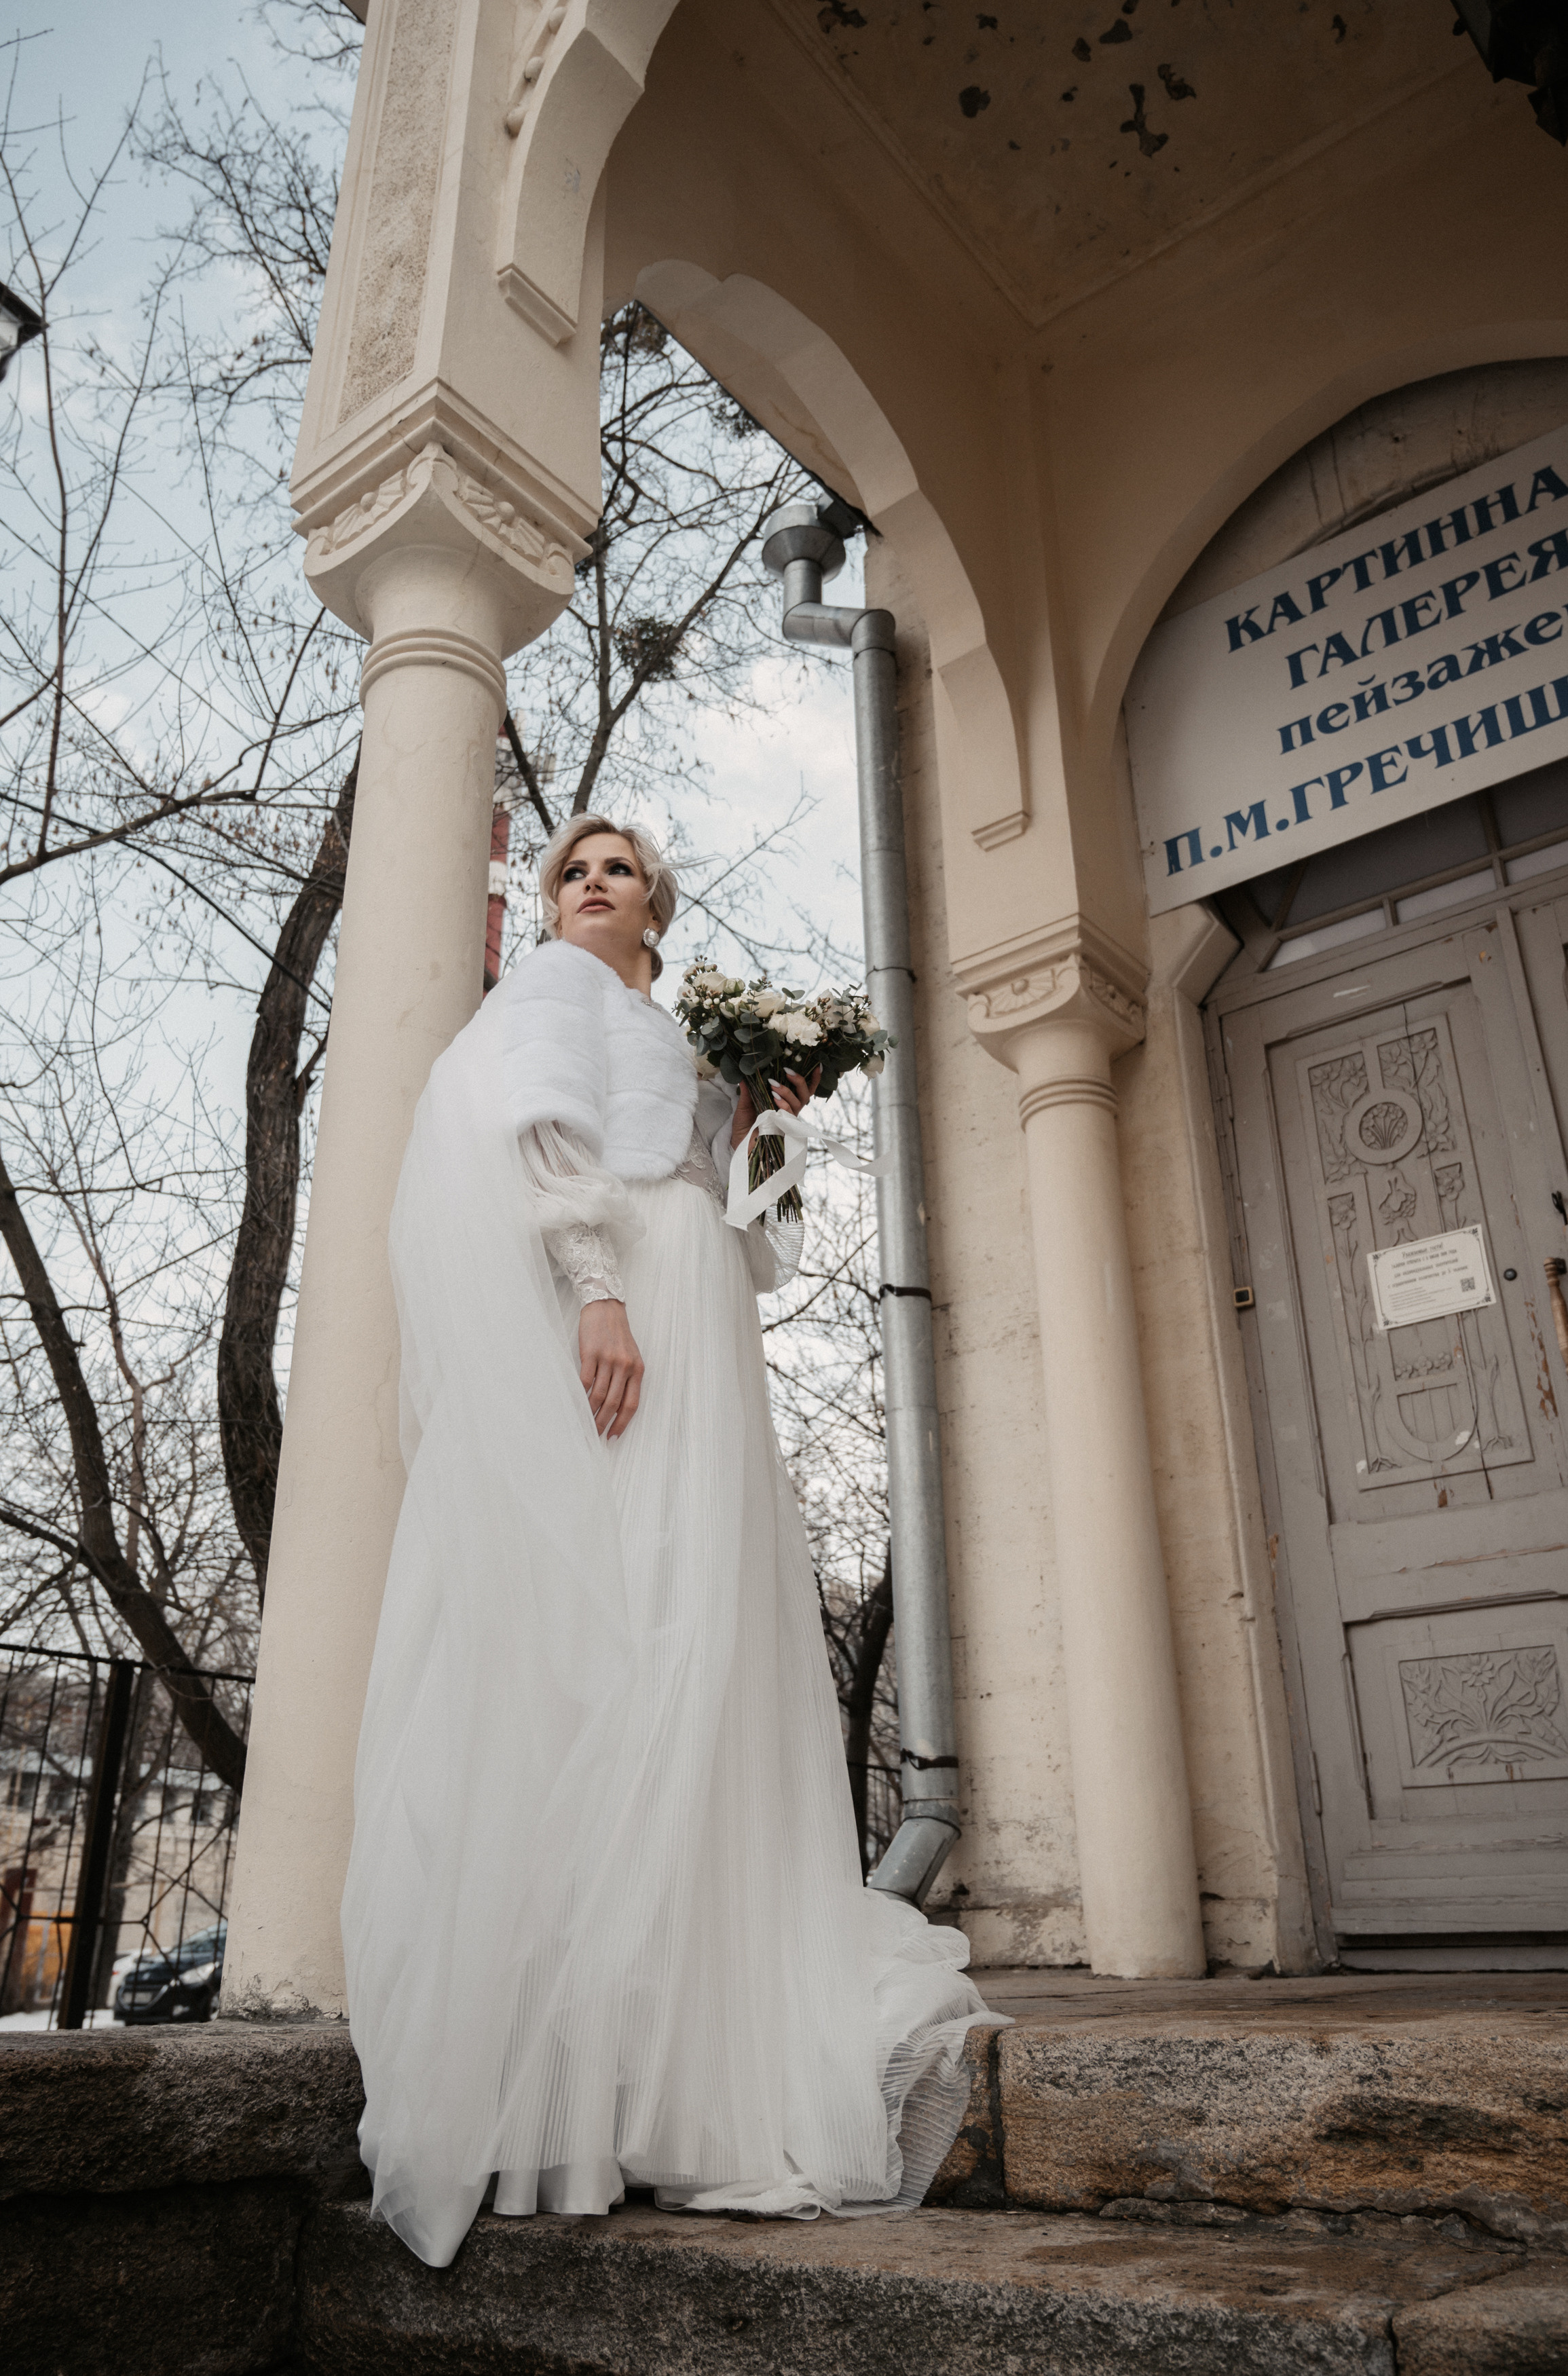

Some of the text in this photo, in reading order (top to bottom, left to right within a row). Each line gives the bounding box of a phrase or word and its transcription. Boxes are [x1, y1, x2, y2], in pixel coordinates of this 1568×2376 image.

[1224, 465, 1568, 653] КАРТИННА
[1284, 527, 1568, 690] ГАЛЕРЕЯ
[1277, 603, 1568, 755] пейзаже
